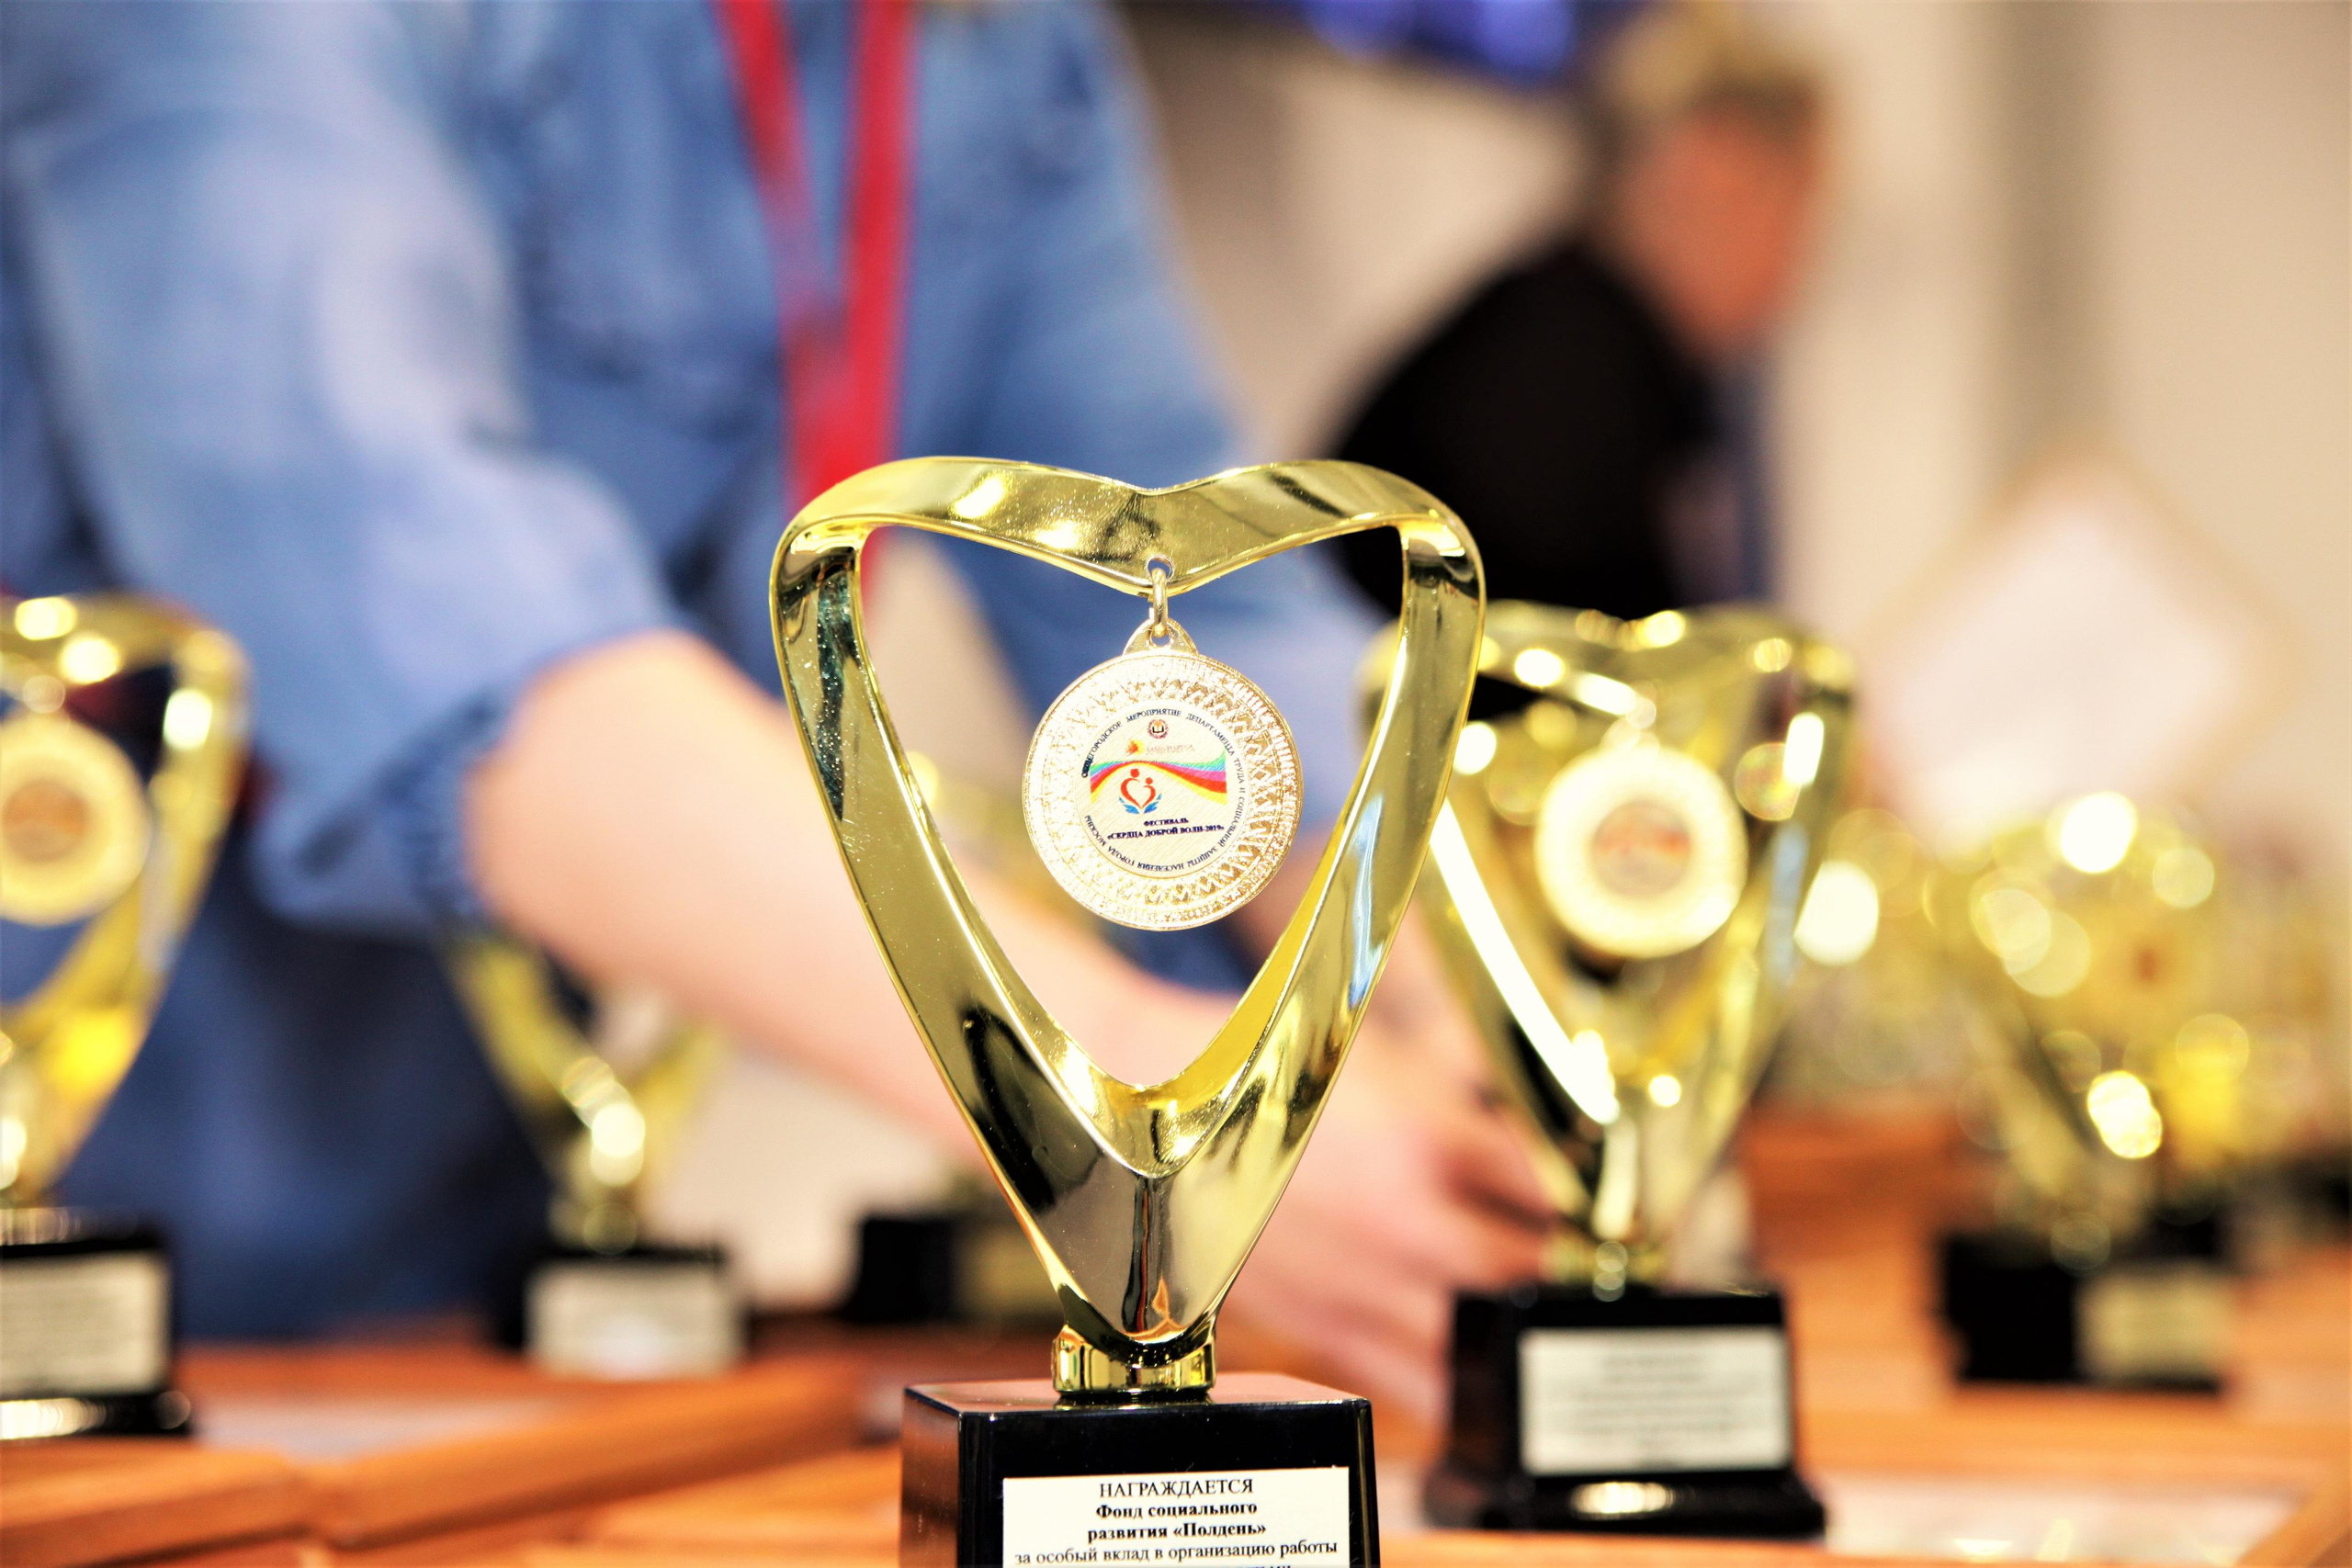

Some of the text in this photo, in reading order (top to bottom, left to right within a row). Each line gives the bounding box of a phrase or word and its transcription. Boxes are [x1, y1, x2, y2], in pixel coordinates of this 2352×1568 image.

[1126, 709, 1182, 722] МЕРОПРИЯТИЕ
[1186, 714, 1235, 756] ДЕПАРТАМЕНТА
[1234, 758, 1245, 784] ТРУДА
[1084, 815, 1106, 847] МОСКВЫ
[1143, 818, 1189, 827] ФЕСТИВАЛЬ
[1218, 796, 1245, 847] СОЦИАЛЬНОЙ
[1107, 831, 1144, 840] «СЕРДЦА
[1145, 827, 1179, 838] ДОБРОЙ
[1108, 845, 1135, 866] ГОРОДА
[1187, 846, 1218, 868] ЗАЩИТЫ
[1136, 862, 1184, 872] НАСЕЛЕНИЯ
[1099, 1479, 1253, 1499] НАГРАЖДАЕТСЯ
[1096, 1502, 1258, 1519] Фонд социального
[1088, 1522, 1267, 1544] развития «Полдень»
[1014, 1539, 1338, 1564] за особый вклад в организацию работы
